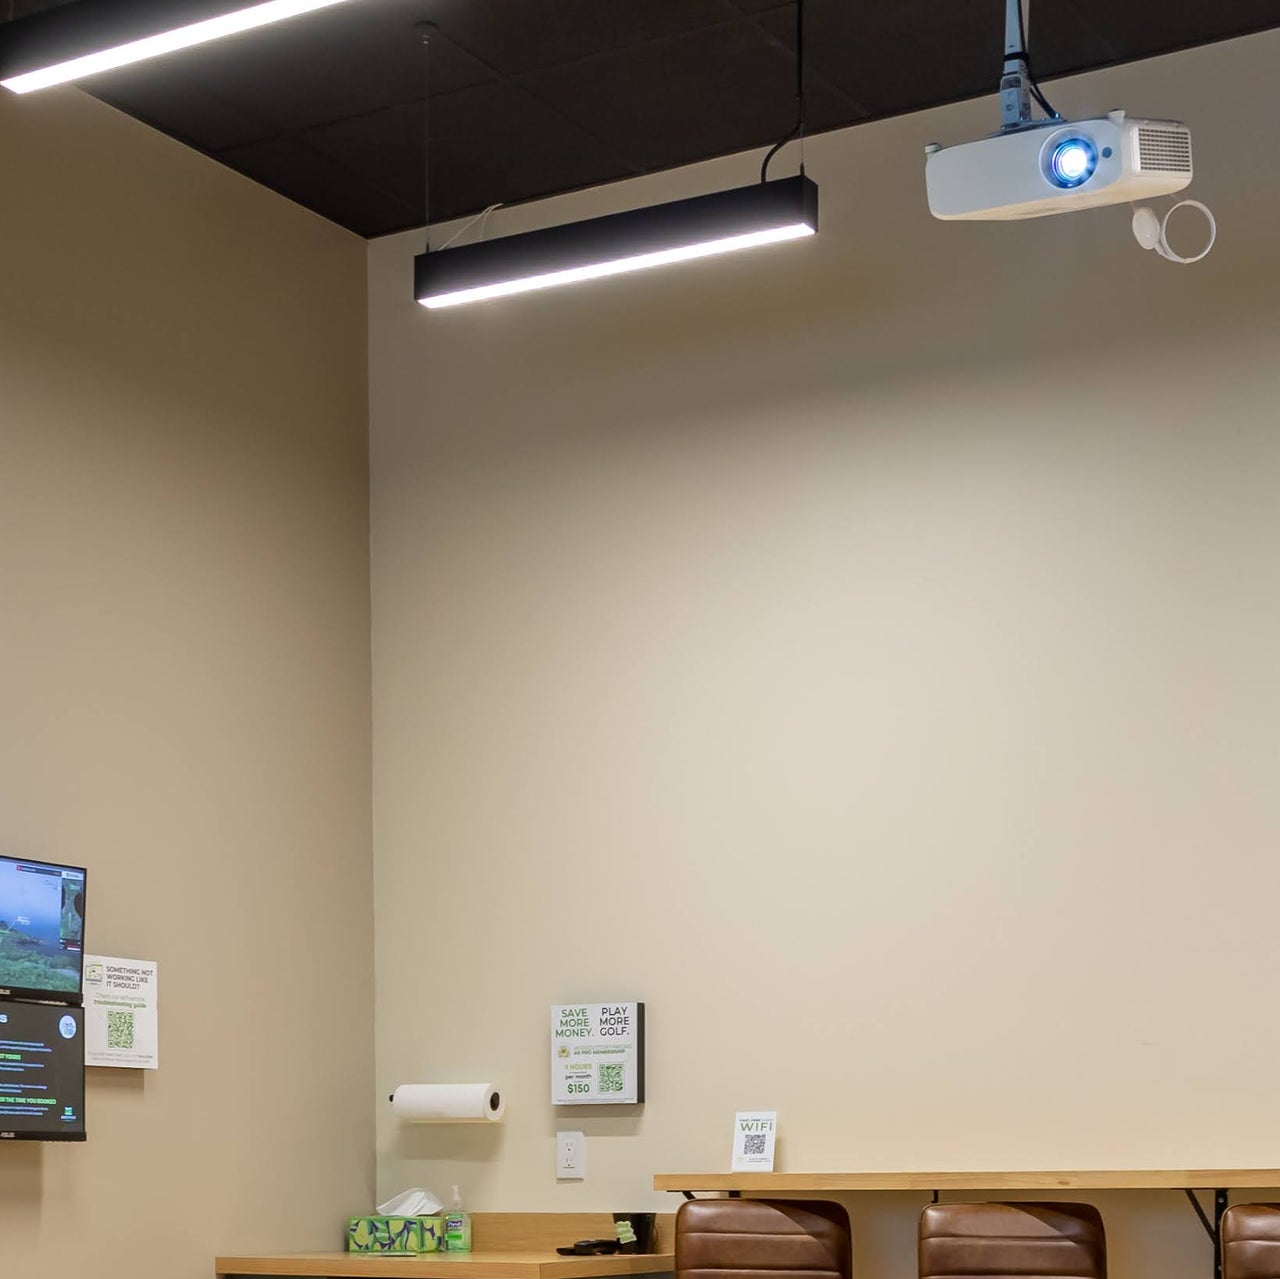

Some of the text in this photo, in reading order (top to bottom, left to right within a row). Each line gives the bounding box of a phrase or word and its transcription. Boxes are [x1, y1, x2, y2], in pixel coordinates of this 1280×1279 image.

[106, 966, 140, 975] SOMETHING
[561, 1009, 587, 1018] SAVE
[602, 1007, 628, 1016] PLAY
[560, 1018, 589, 1028] MORE
[600, 1017, 629, 1026] MORE
[555, 1028, 594, 1038] MONEY.
[600, 1027, 629, 1036] GOLF.
[567, 1083, 590, 1094] $150
[740, 1122, 773, 1131] WIFI
